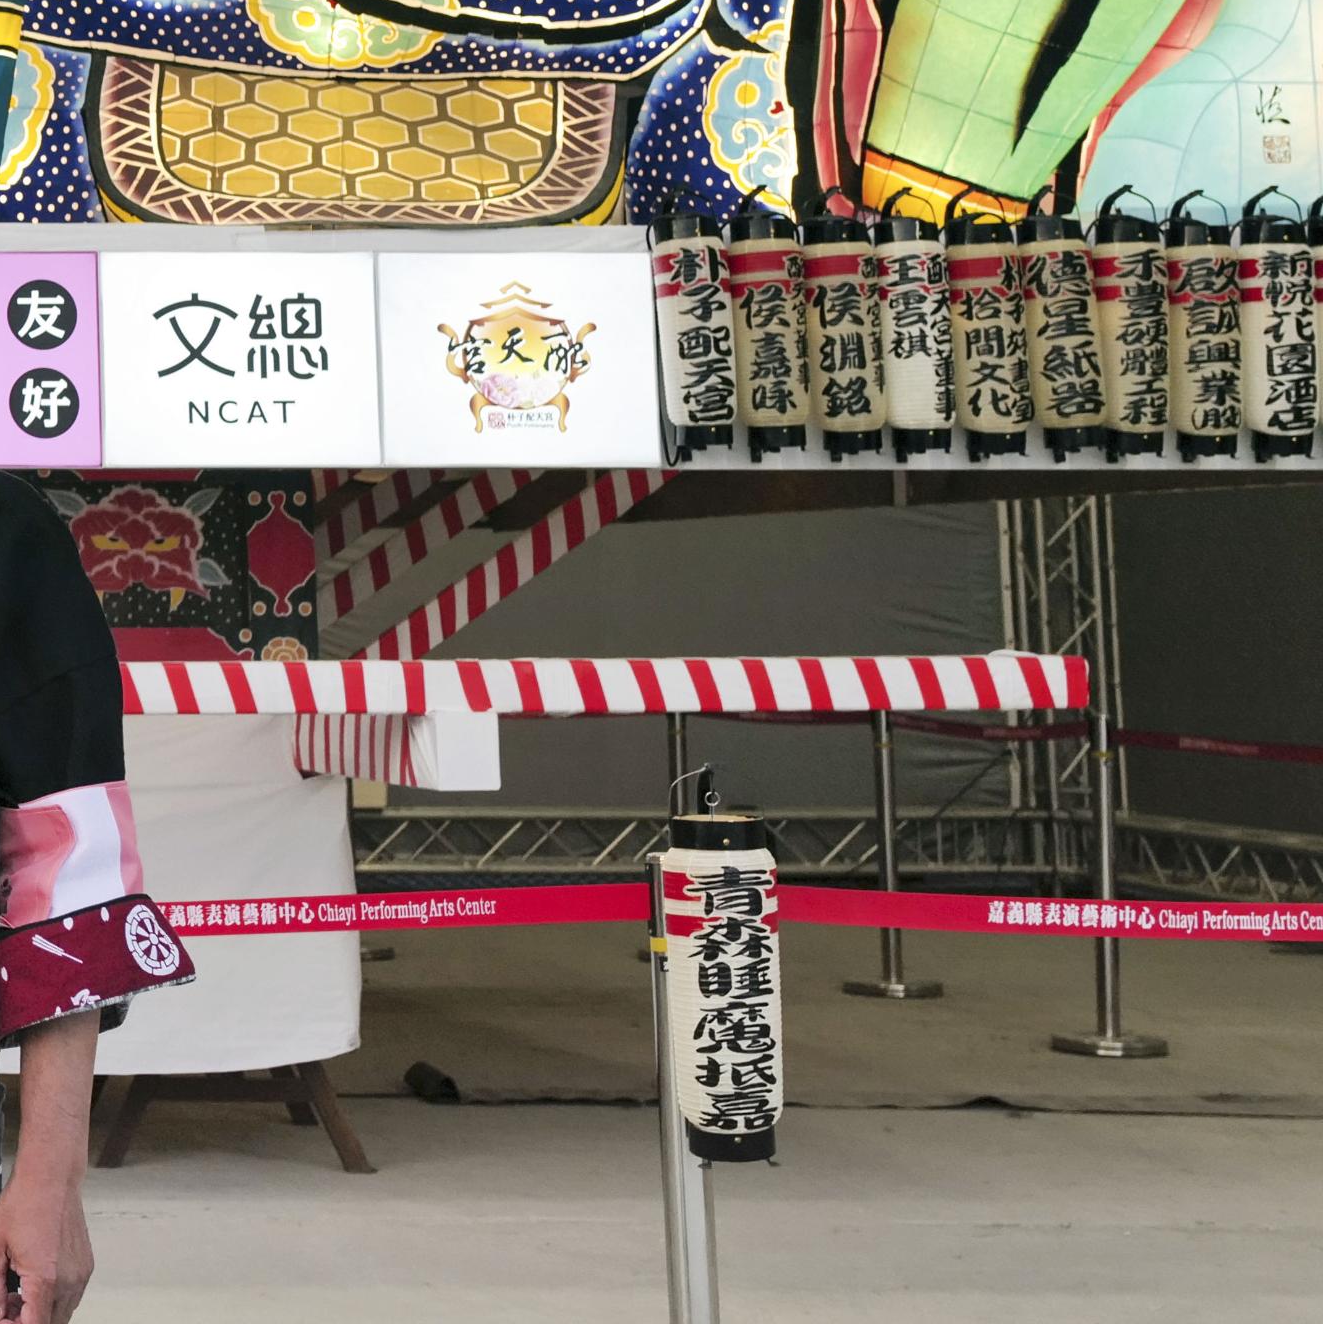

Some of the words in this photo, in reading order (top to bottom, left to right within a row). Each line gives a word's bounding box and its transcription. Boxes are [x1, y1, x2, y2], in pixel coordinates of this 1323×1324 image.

[15, 289, 72, 430] 友好
[152, 292, 329, 380] 文總
[670, 245, 735, 424] 朴子配天宮
[886, 253, 934, 360] 王雲祺
[1027, 251, 1105, 418] 德星紙器
[1115, 249, 1169, 425] 禾豐硬體工程
[189, 400, 296, 424] NCAT
[318, 902, 357, 925] Chiayi
[361, 900, 428, 924] Performing
[430, 897, 455, 917] Arts
[456, 896, 497, 916] Center
[987, 900, 1156, 930] 嘉義縣表演藝術中心
[1158, 909, 1199, 934] Chiayi
[1203, 909, 1272, 936] Performing
[1272, 911, 1299, 930] Arts
[684, 865, 778, 1132] 青森睡魔抵嘉
